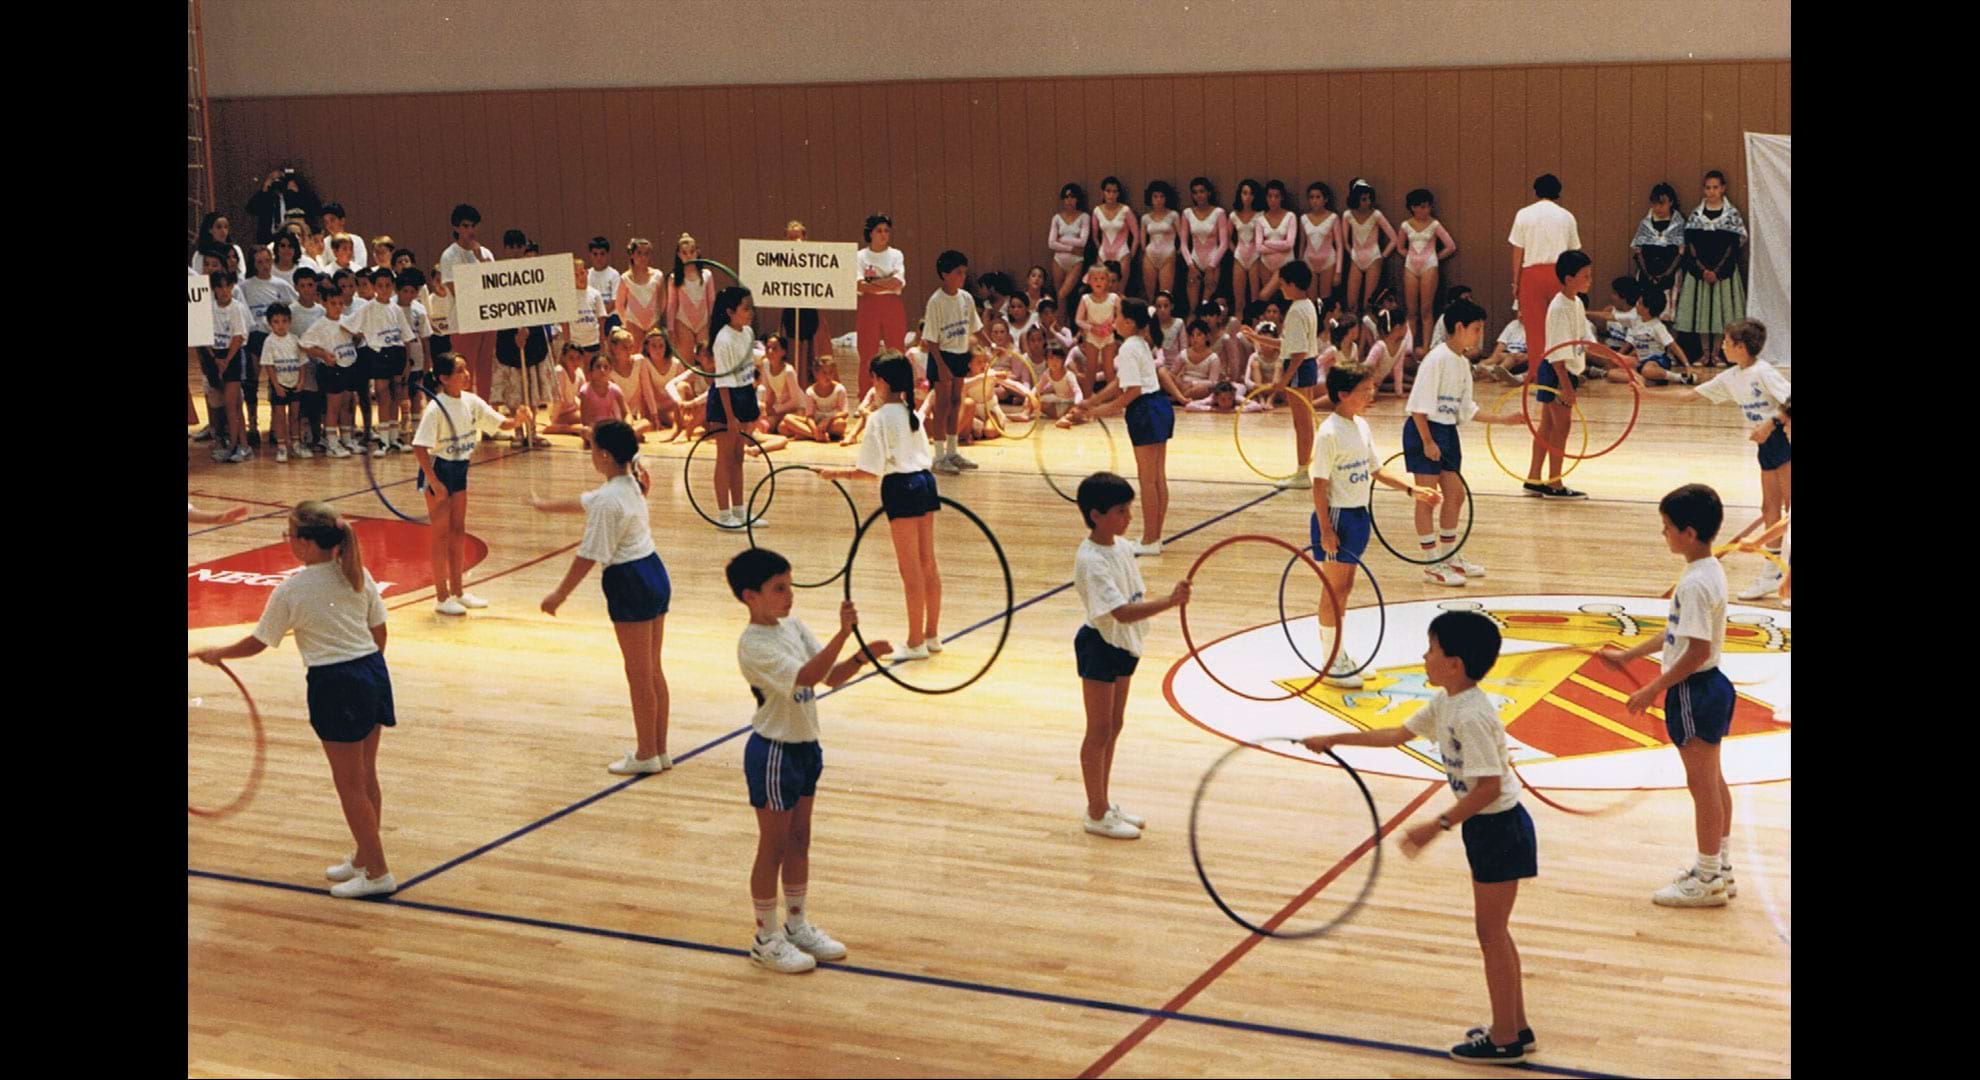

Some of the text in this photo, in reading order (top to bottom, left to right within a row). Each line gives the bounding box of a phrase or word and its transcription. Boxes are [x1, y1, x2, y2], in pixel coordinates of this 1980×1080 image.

[481, 268, 545, 289] INICIACIO
[762, 281, 834, 298] ARTISTICA
[479, 297, 557, 320] ESPORTIVA
